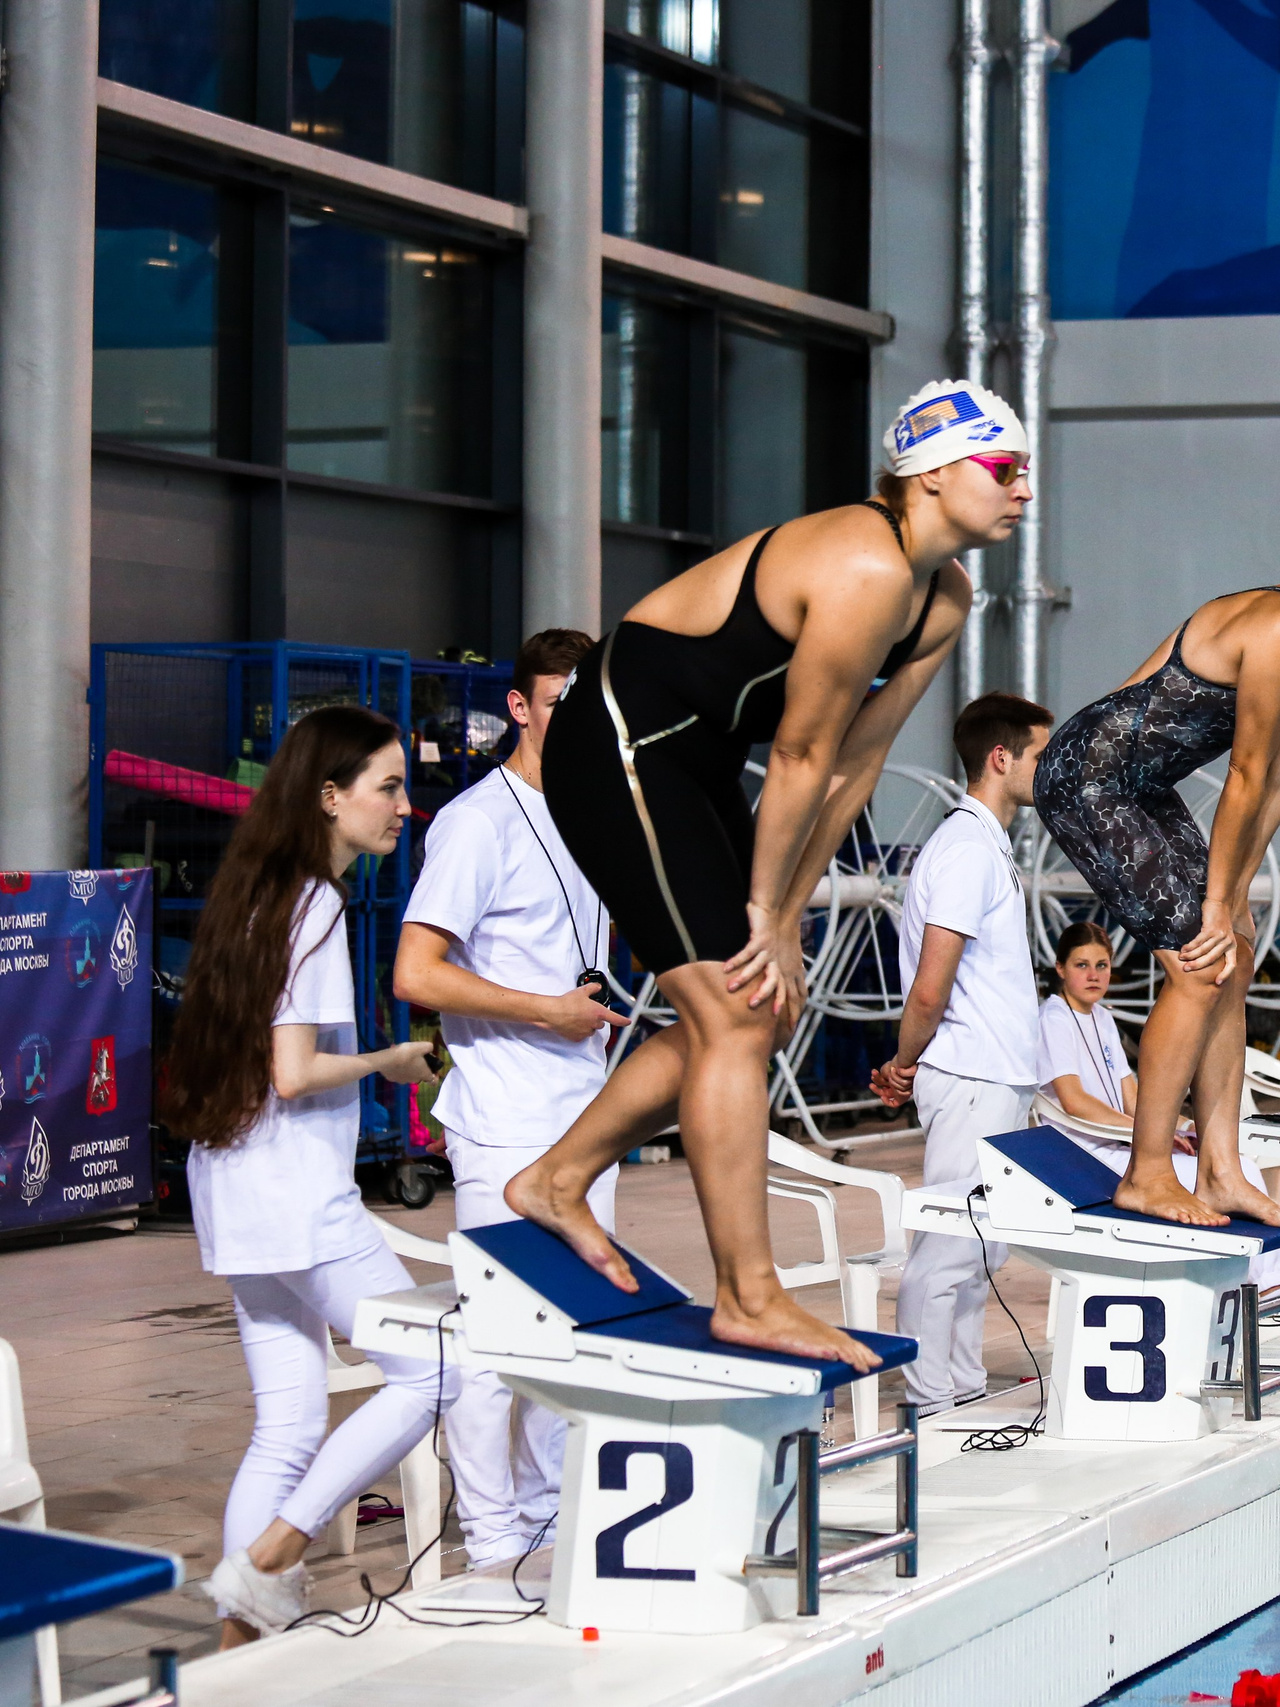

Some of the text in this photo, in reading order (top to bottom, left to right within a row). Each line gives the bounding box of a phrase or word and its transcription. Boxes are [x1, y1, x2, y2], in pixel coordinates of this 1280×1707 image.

[14, 954, 49, 971] МОСКВЫ
[69, 1136, 130, 1162] ДЕПАРТАМЕНТ
[83, 1159, 118, 1177] СПОРТА
[63, 1175, 134, 1202] ГОРОДА МОСКВЫ
[1210, 1288, 1240, 1381] 3
[1083, 1295, 1167, 1402] 3
[596, 1440, 697, 1582] 2
